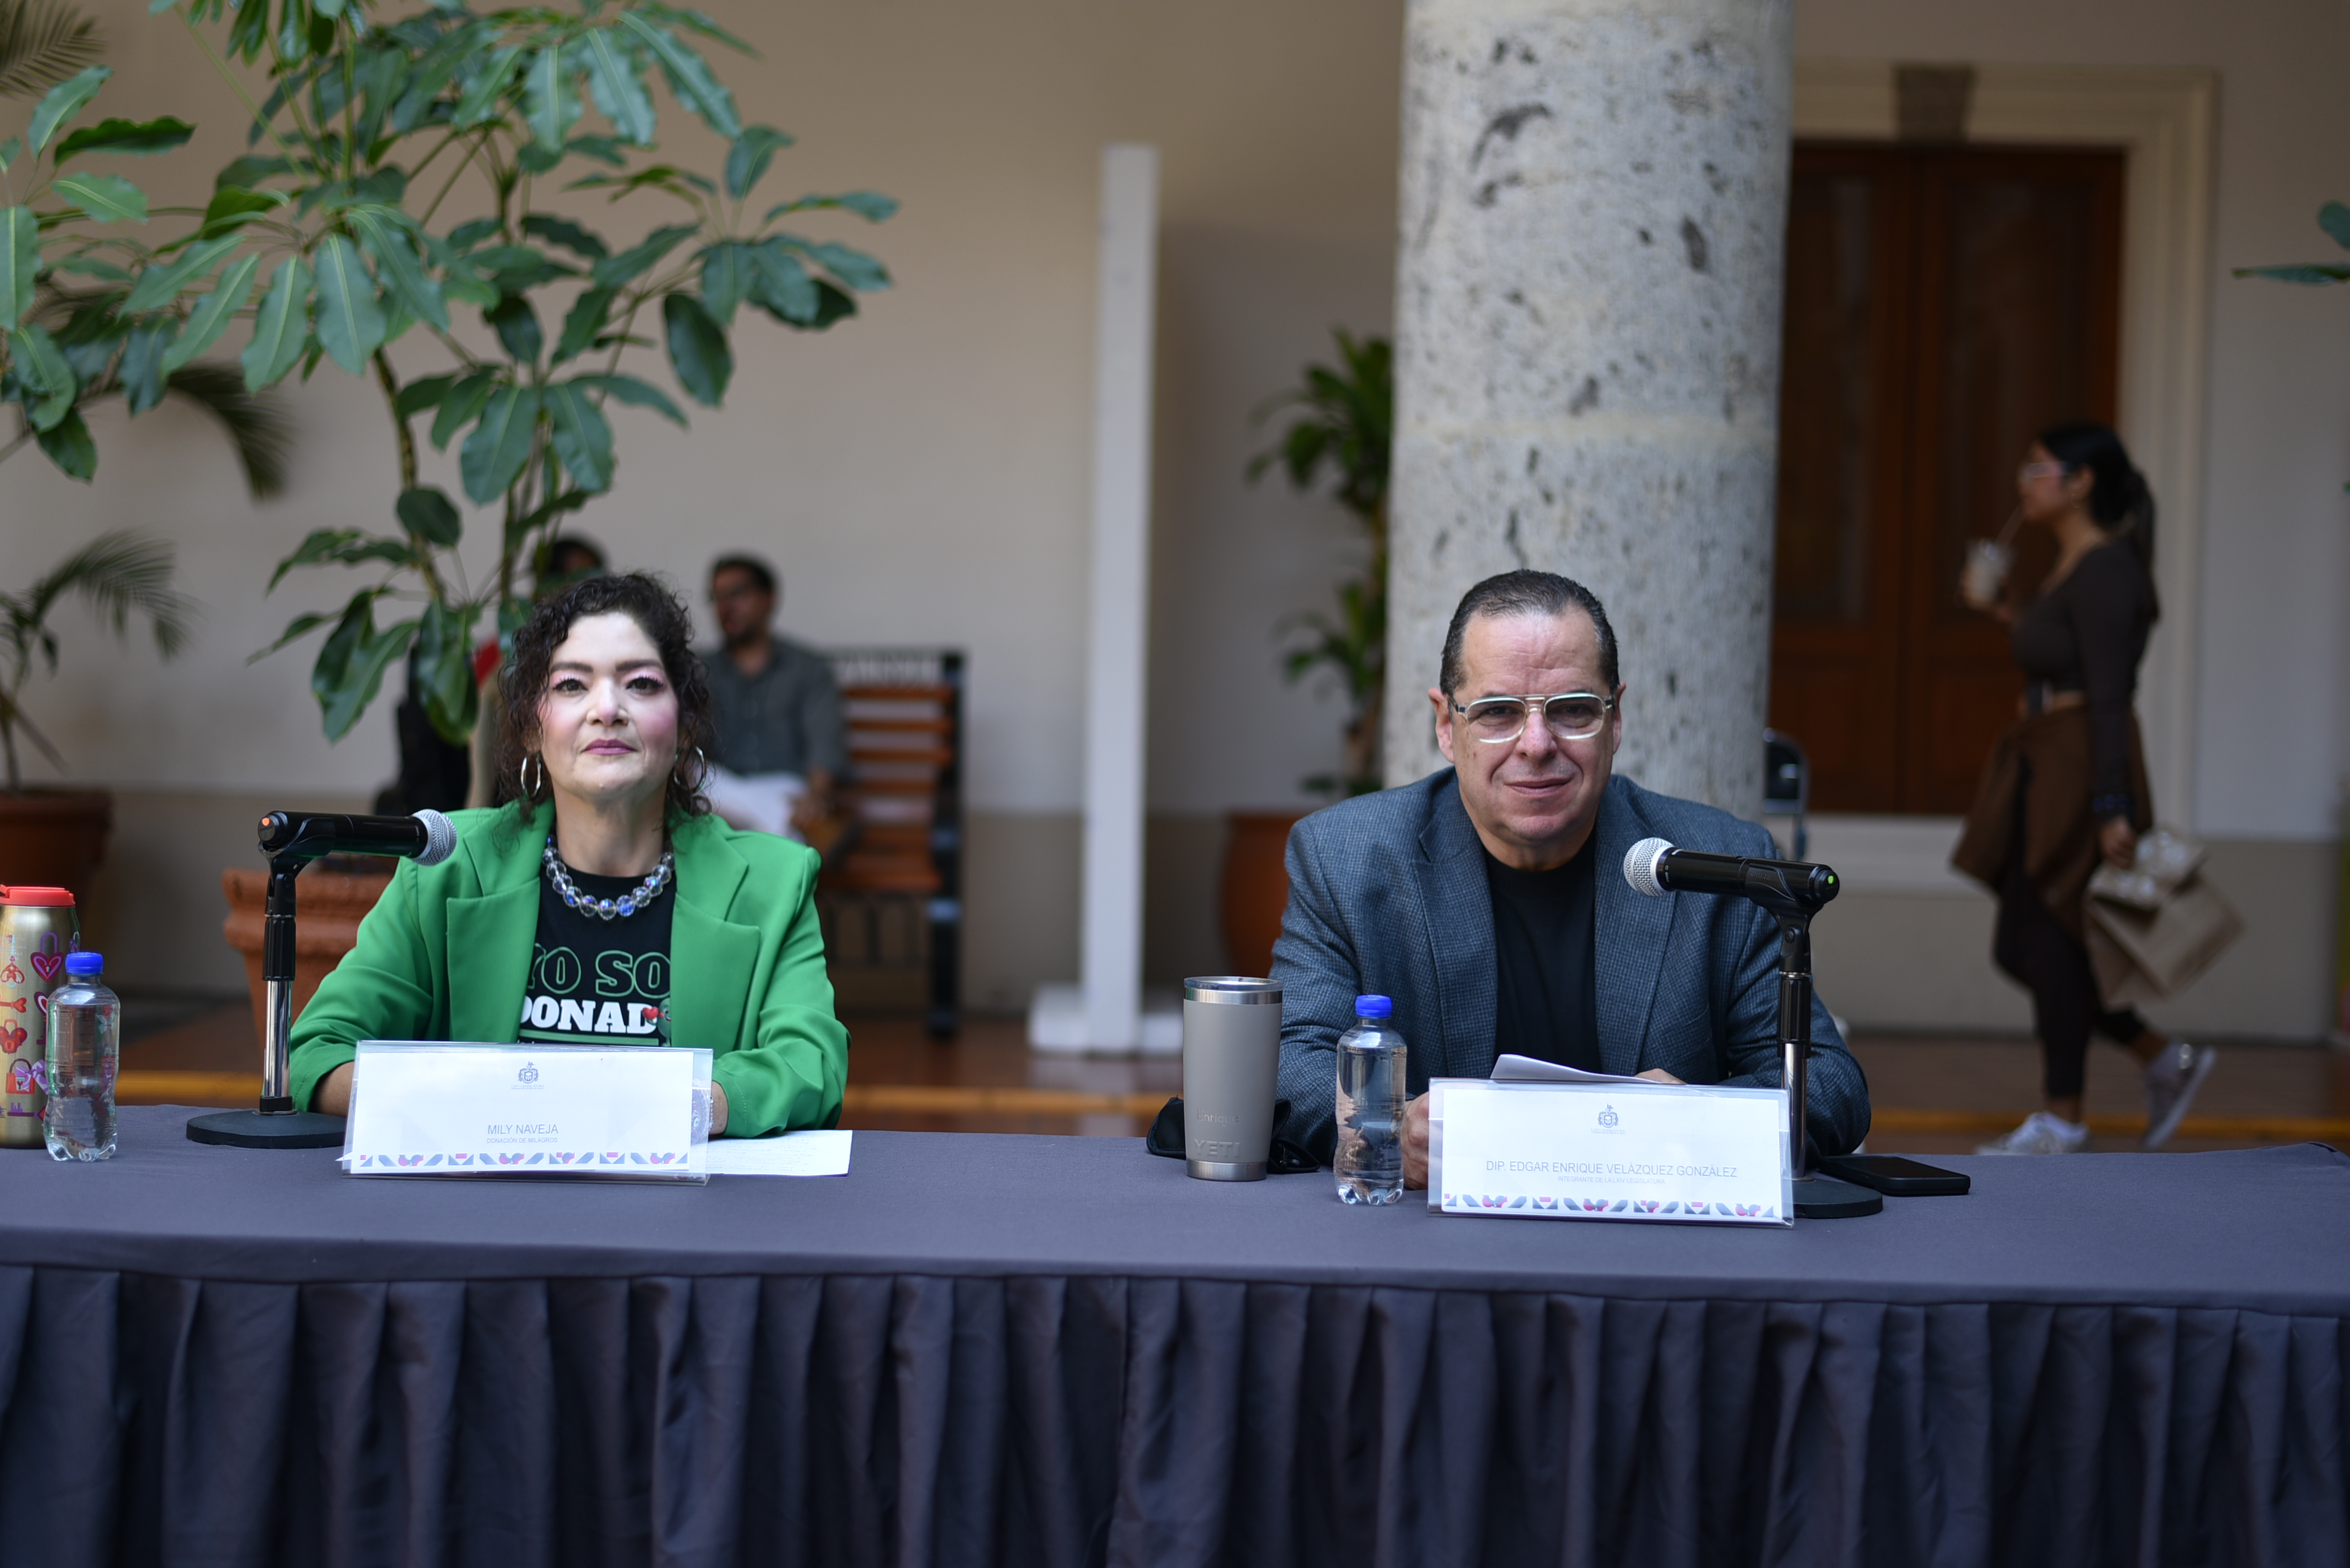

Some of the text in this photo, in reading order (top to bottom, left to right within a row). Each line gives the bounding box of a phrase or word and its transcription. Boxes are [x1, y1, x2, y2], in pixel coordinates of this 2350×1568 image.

[1197, 1108, 1239, 1127] Enrique
[487, 1124, 559, 1135] MILY NAVEJA
[1194, 1138, 1241, 1158] YETI
[1486, 1160, 1738, 1177] DIP. EDGAR ENRIQUE VELÁZQUEZ GONZÁLEZ
